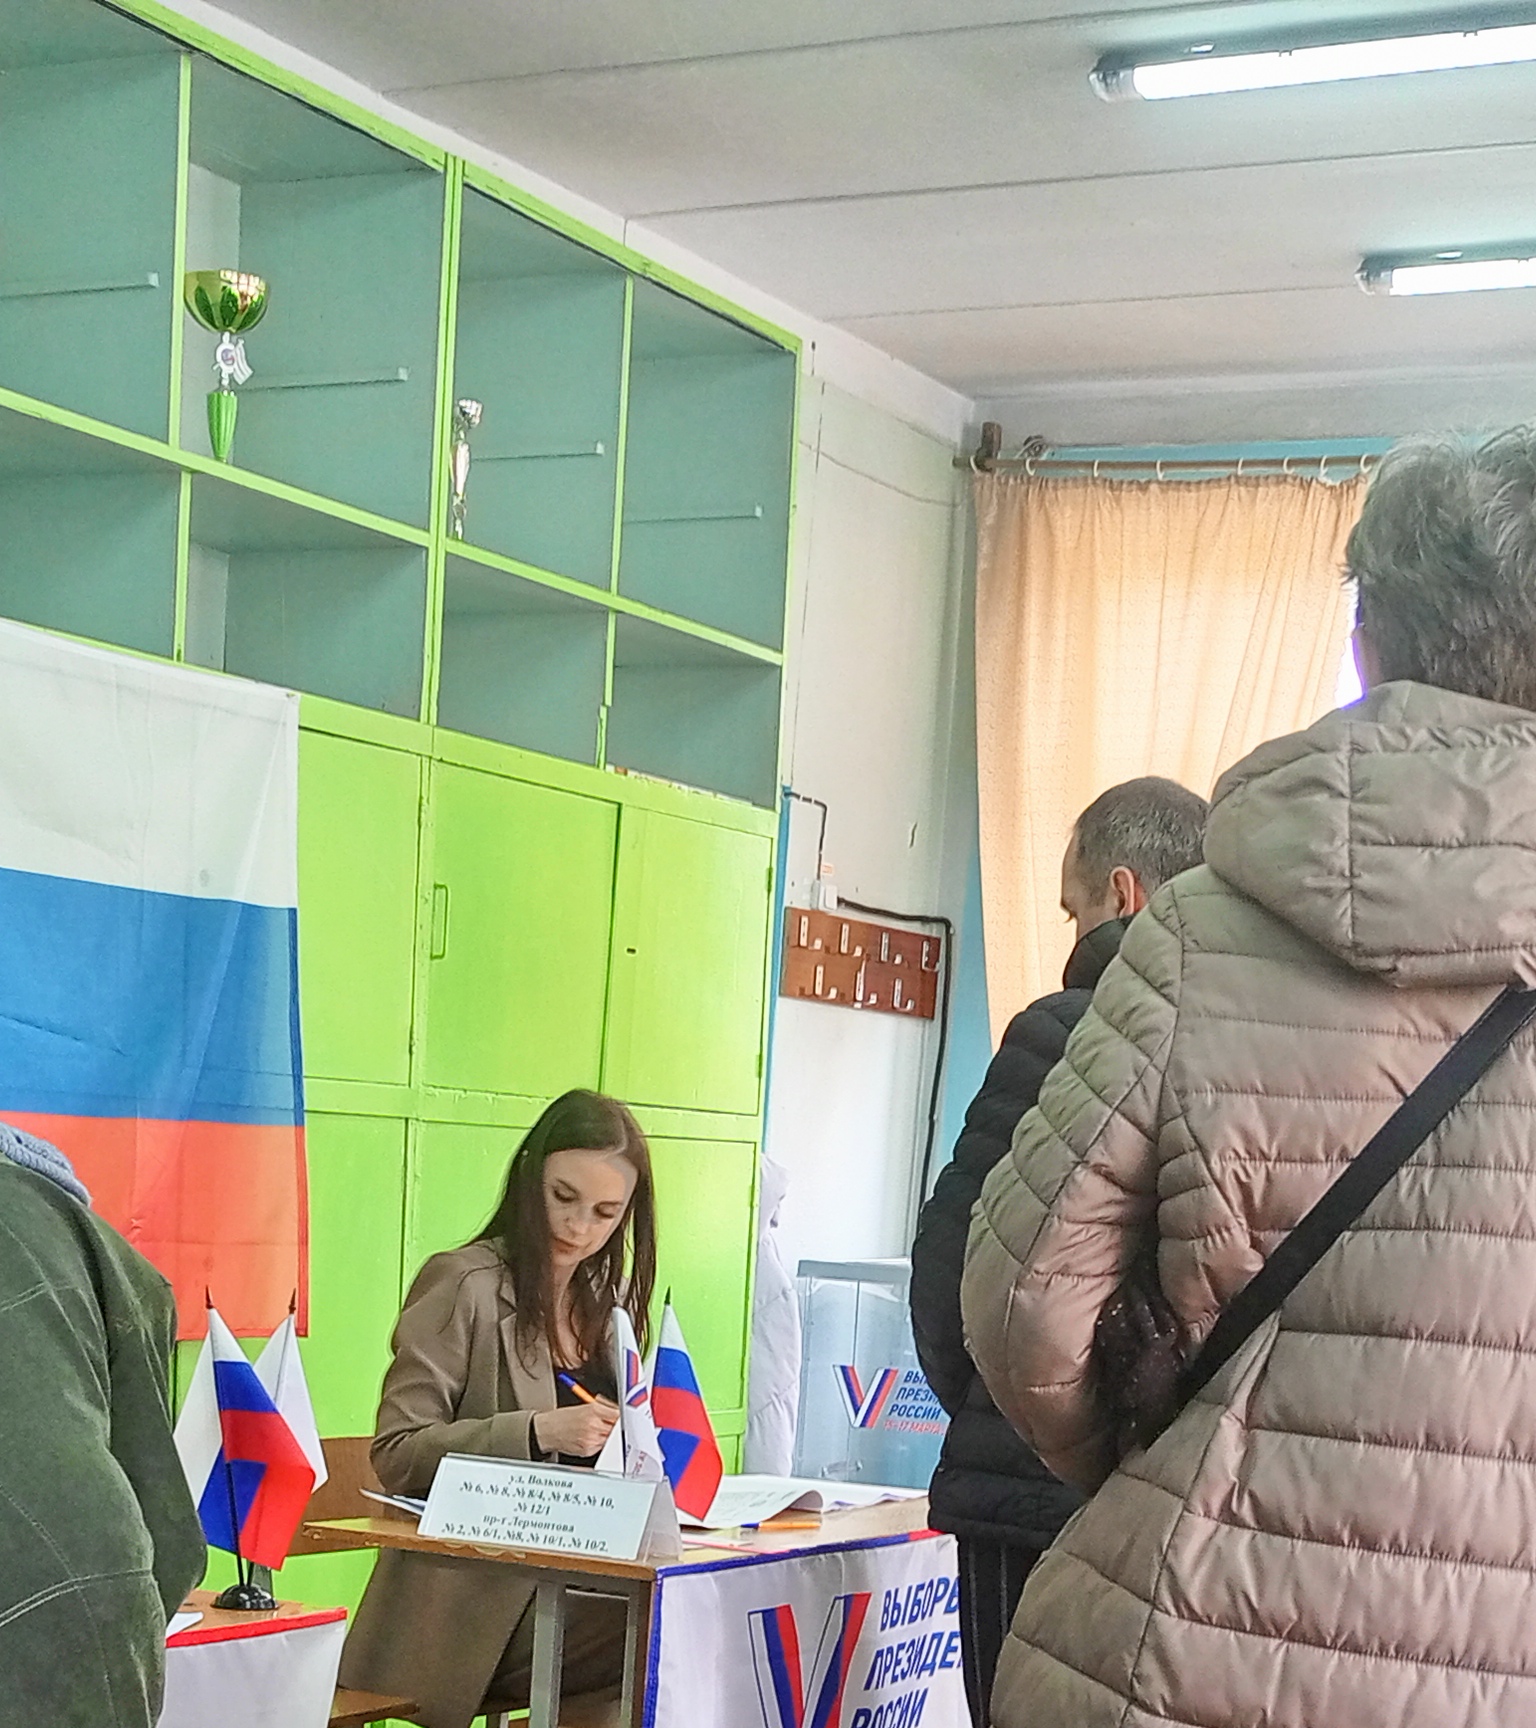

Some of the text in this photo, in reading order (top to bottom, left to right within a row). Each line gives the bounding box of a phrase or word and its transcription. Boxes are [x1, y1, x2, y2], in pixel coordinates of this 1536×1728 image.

[903, 1370, 927, 1385] ВЫ
[888, 1403, 942, 1421] РОССИИ
[508, 1474, 573, 1488] ул. Волкова
[460, 1481, 615, 1509] № 6, № 8, № 8/4, № 8/5, № 10,
[514, 1502, 551, 1516] № 12/1
[483, 1515, 575, 1532] пр-т Лермонтова
[441, 1523, 455, 1534] №
[456, 1524, 466, 1536] 2,
[468, 1525, 481, 1537] №
[526, 1532, 540, 1544] №
[568, 1537, 582, 1548] №
[864, 1630, 962, 1691] ПРЕЗИДЕ
